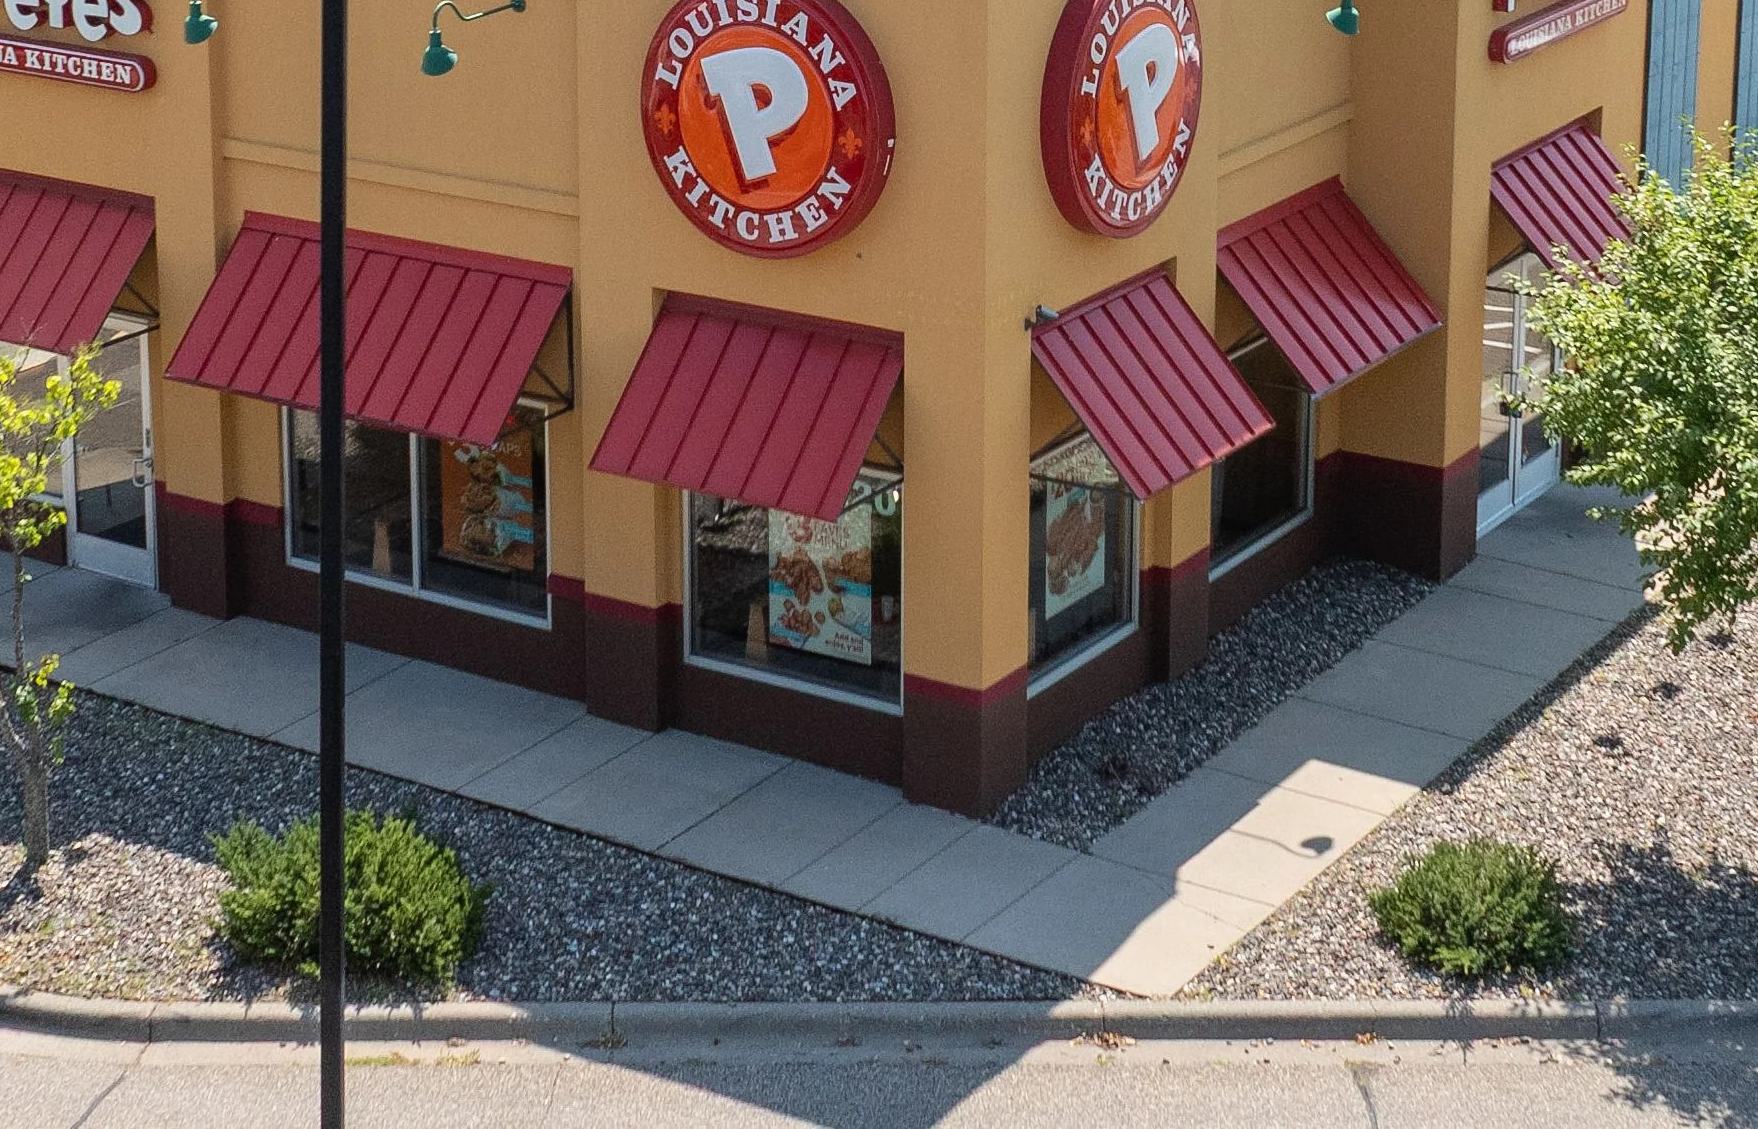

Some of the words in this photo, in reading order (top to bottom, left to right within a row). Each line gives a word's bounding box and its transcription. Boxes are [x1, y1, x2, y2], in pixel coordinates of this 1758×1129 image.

[23, 48, 132, 85] KITCHEN
[1508, 14, 1572, 55] LOUISIANA
[700, 46, 809, 181] P
[1115, 23, 1178, 161] P
[664, 145, 852, 243] KITCHEN
[1084, 118, 1192, 222] KITCHEN
